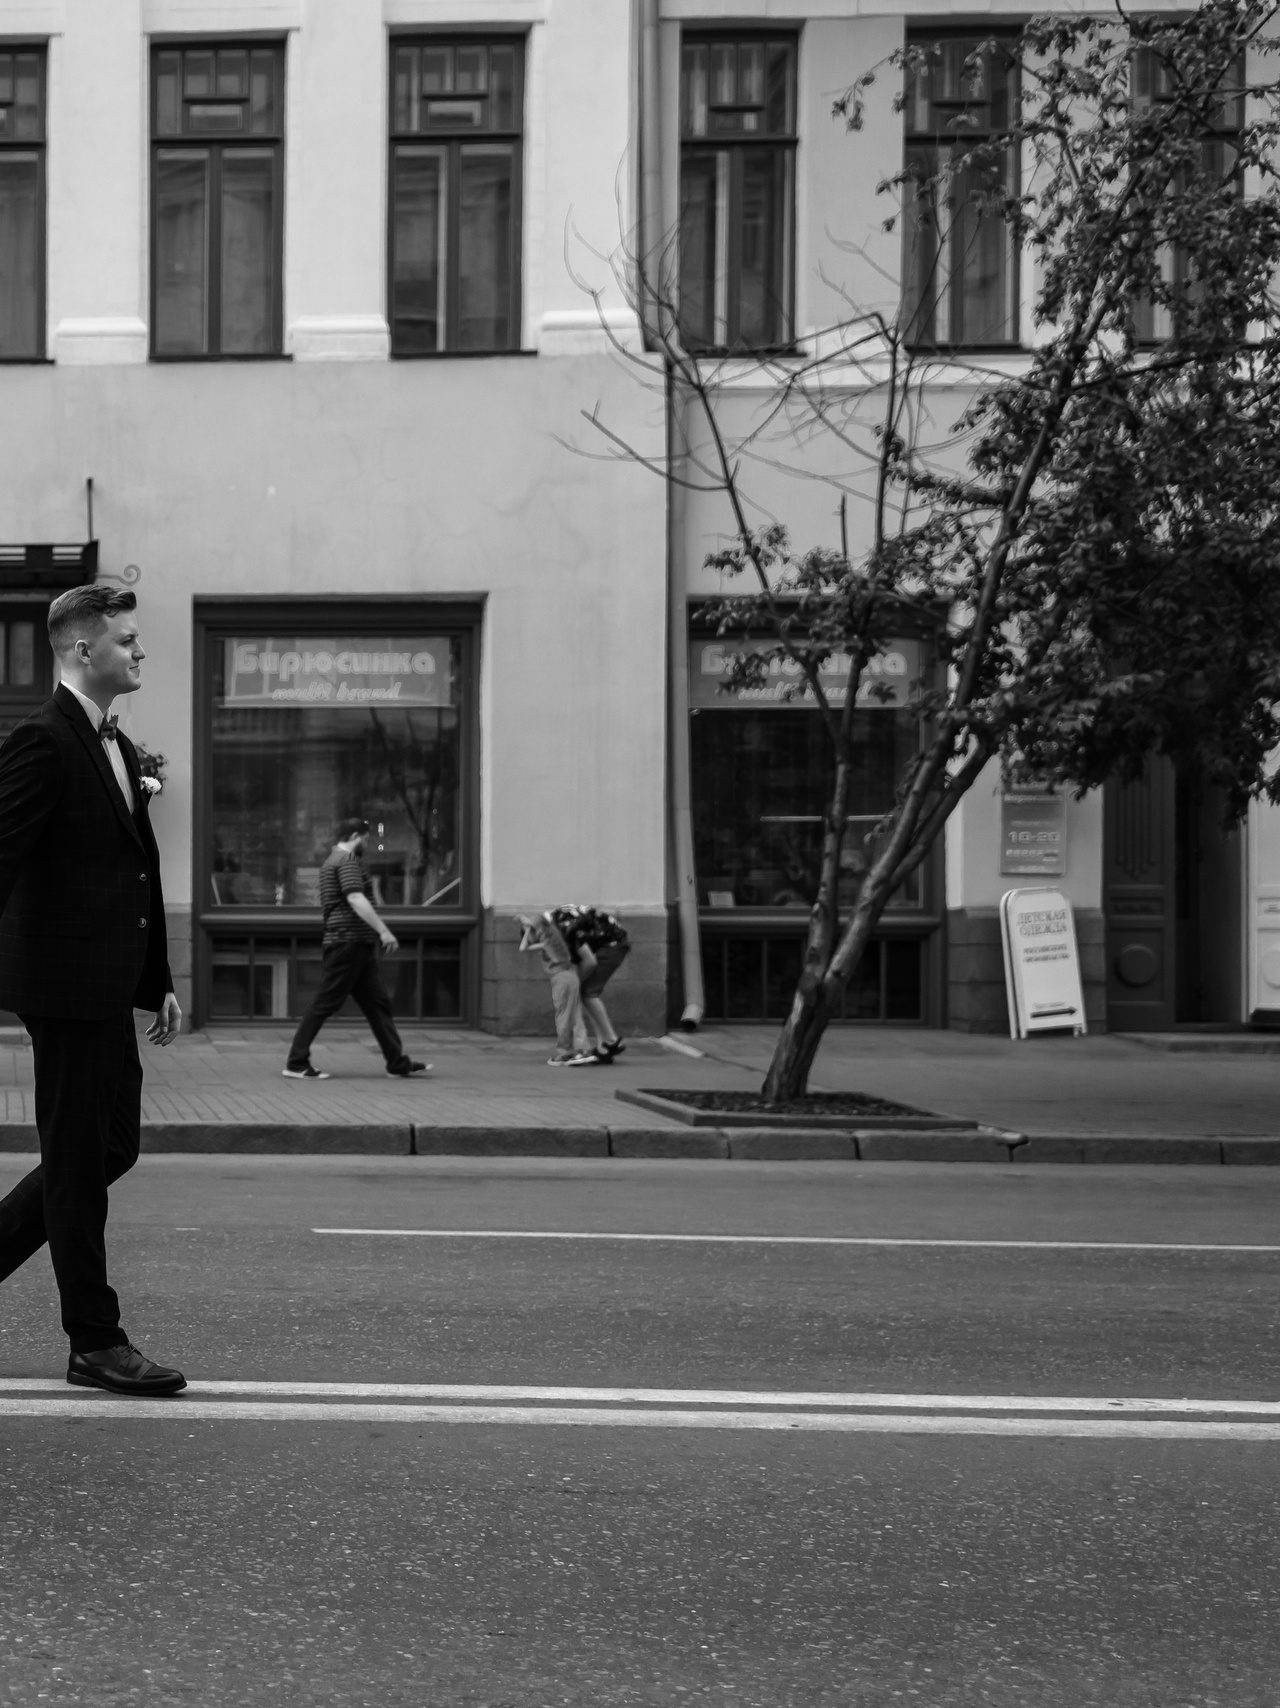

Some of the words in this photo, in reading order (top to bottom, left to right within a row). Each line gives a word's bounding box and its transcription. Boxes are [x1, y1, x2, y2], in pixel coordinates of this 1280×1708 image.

[235, 645, 436, 682] Бирюсинка
[701, 645, 907, 676] Бюинка
[272, 682, 332, 701] multi
[336, 682, 401, 701] brand
[804, 682, 872, 700] bad
[1008, 832, 1060, 844] 10-20
